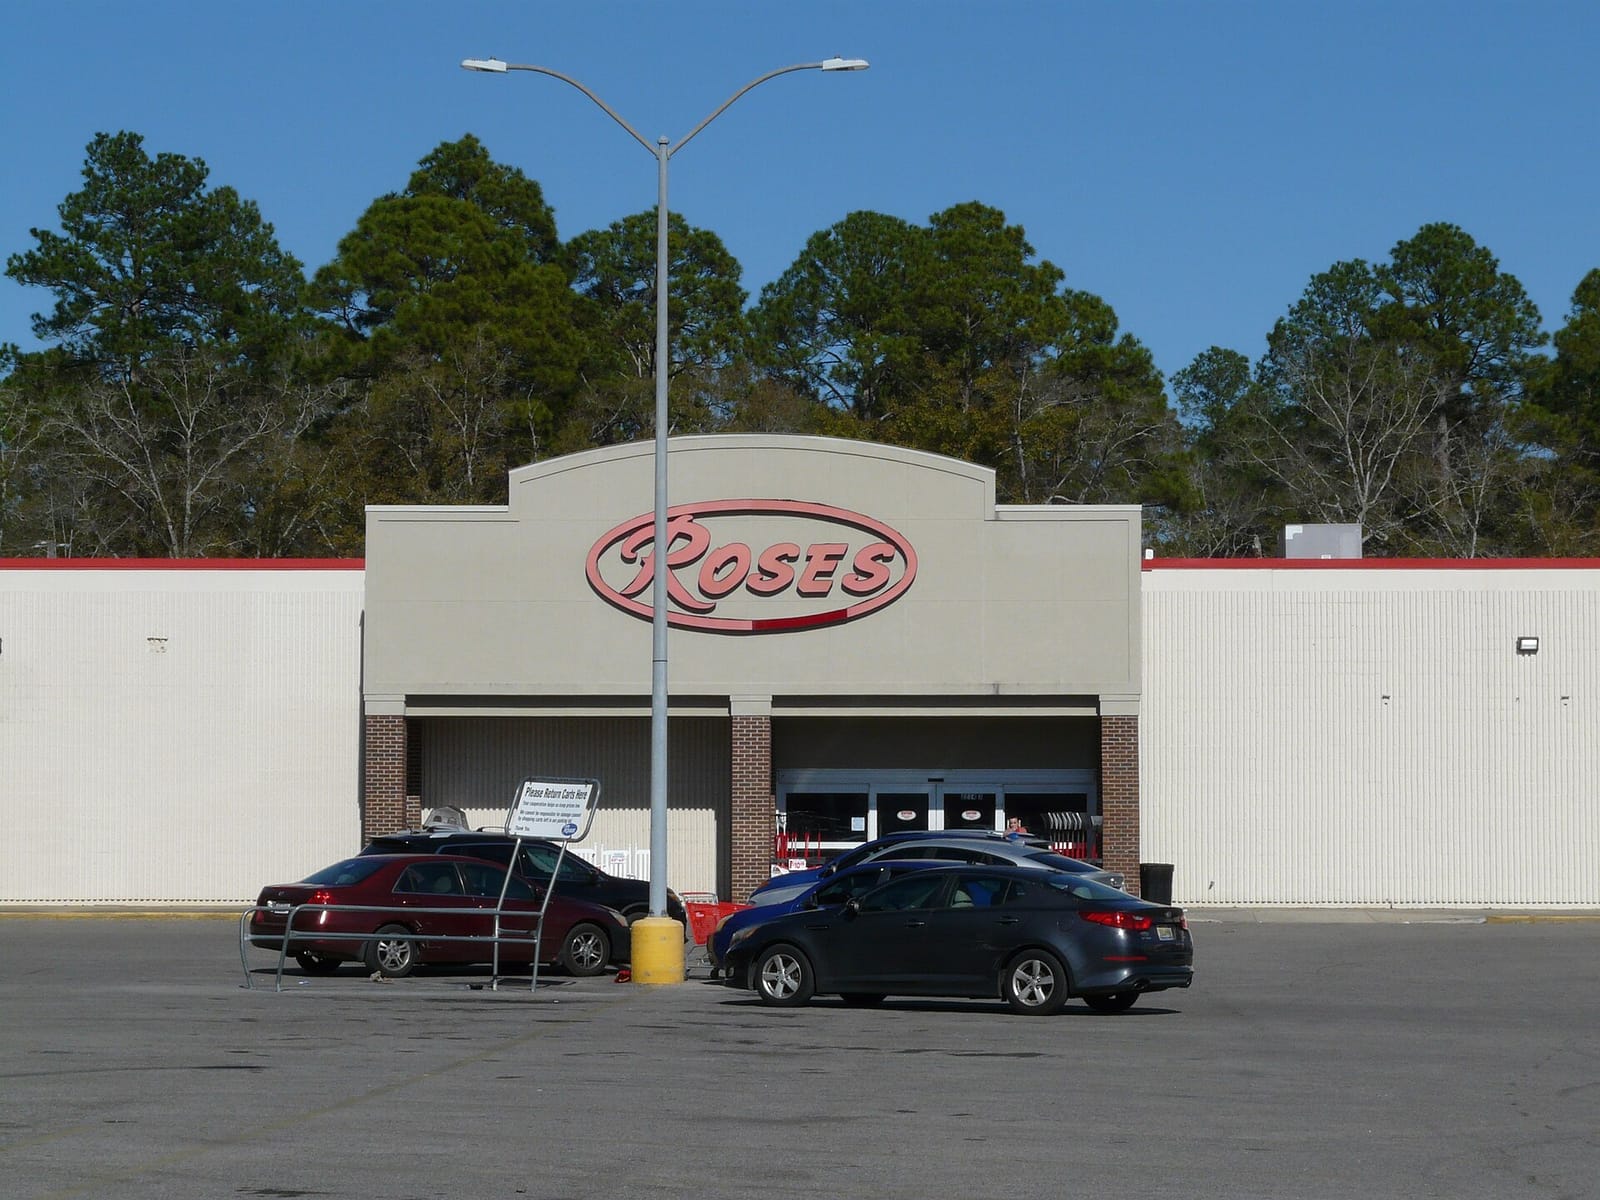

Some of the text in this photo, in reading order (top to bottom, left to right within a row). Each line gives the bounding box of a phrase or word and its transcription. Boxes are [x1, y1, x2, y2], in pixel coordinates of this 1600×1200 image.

[619, 513, 895, 614] ROSES
[525, 786, 588, 800] Please Return Carts Here
